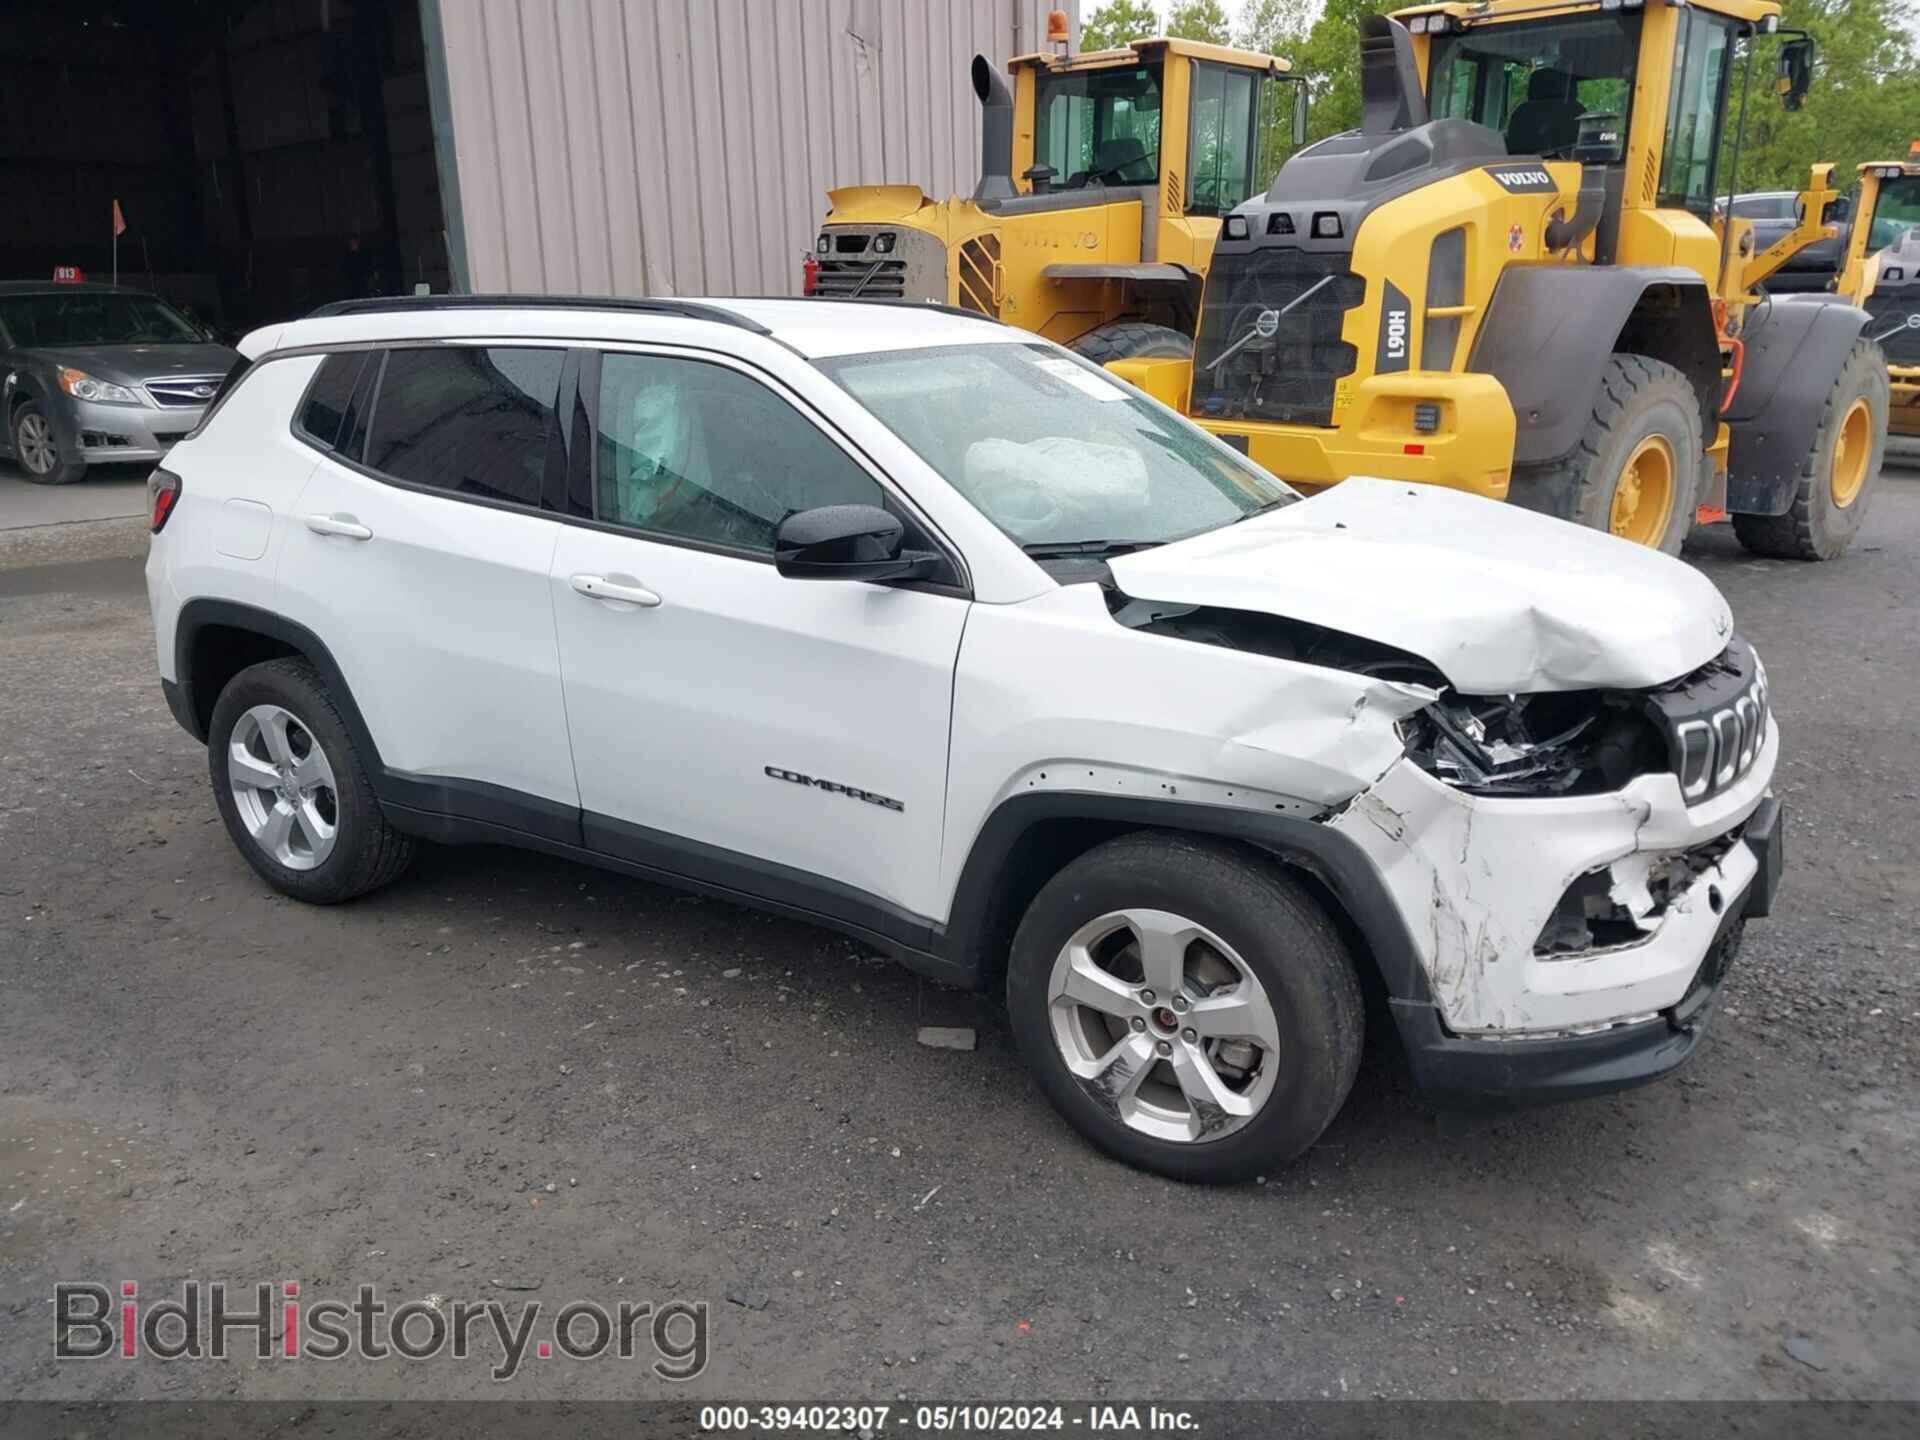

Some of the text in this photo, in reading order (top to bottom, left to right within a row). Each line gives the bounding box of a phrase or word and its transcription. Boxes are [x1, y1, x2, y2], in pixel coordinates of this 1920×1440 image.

[1495, 171, 1549, 186] VOLVO
[1387, 310, 1406, 358] L90H
[764, 765, 905, 813] COMPASS
